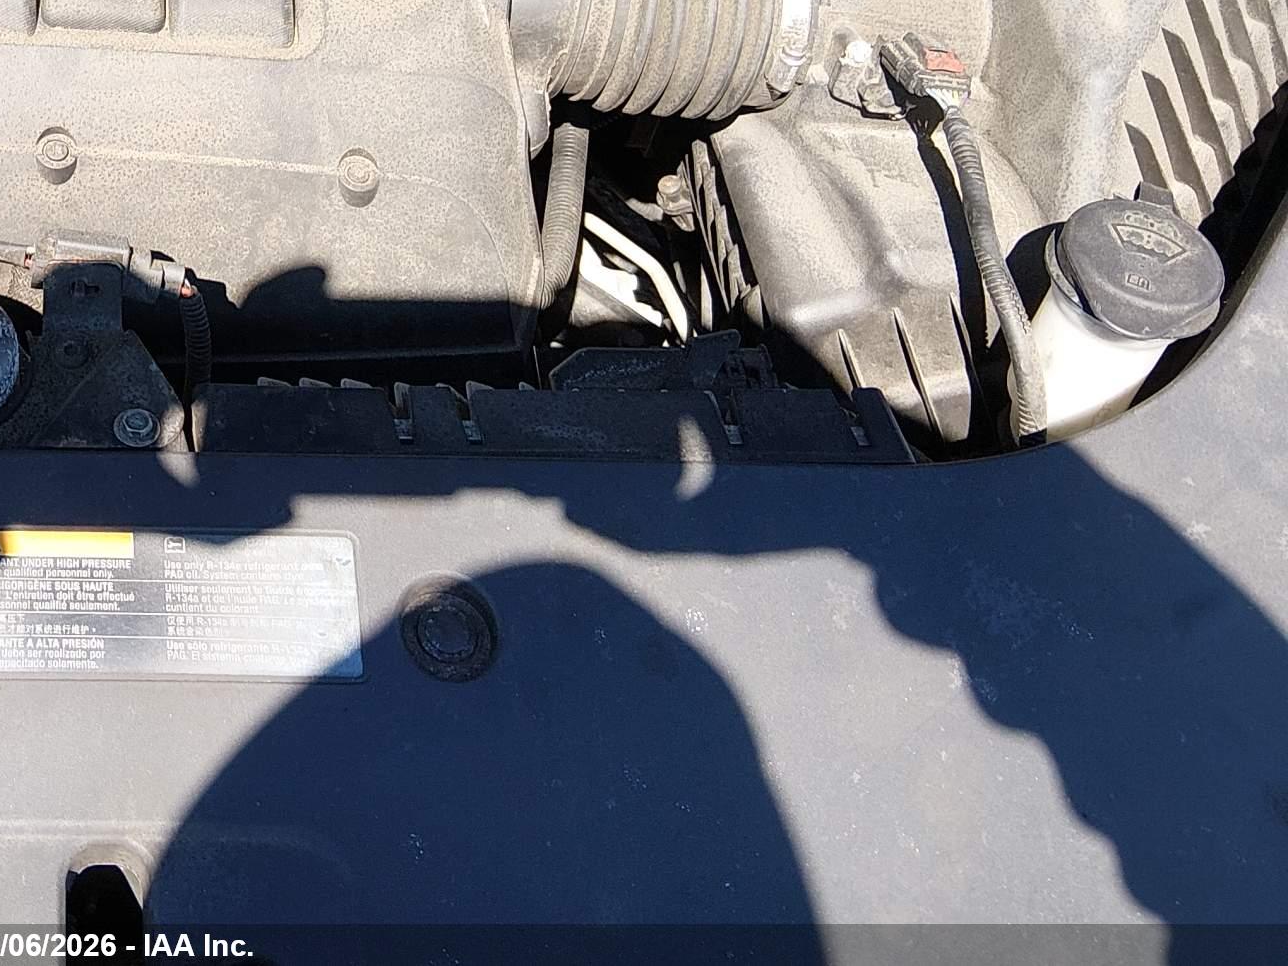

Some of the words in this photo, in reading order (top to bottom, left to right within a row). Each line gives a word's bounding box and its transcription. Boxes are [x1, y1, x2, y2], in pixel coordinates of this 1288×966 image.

[22, 559, 54, 568] UNDER
[57, 559, 79, 568] HIGH
[81, 559, 132, 569] PRESSURE
[4, 568, 44, 578] qualified
[46, 569, 91, 579] personnel
[55, 581, 81, 591] SOUS
[83, 582, 114, 591] HAUTE
[27, 639, 34, 648] A
[36, 639, 60, 649] ALTA
[62, 637, 104, 649] PRESIÓN
